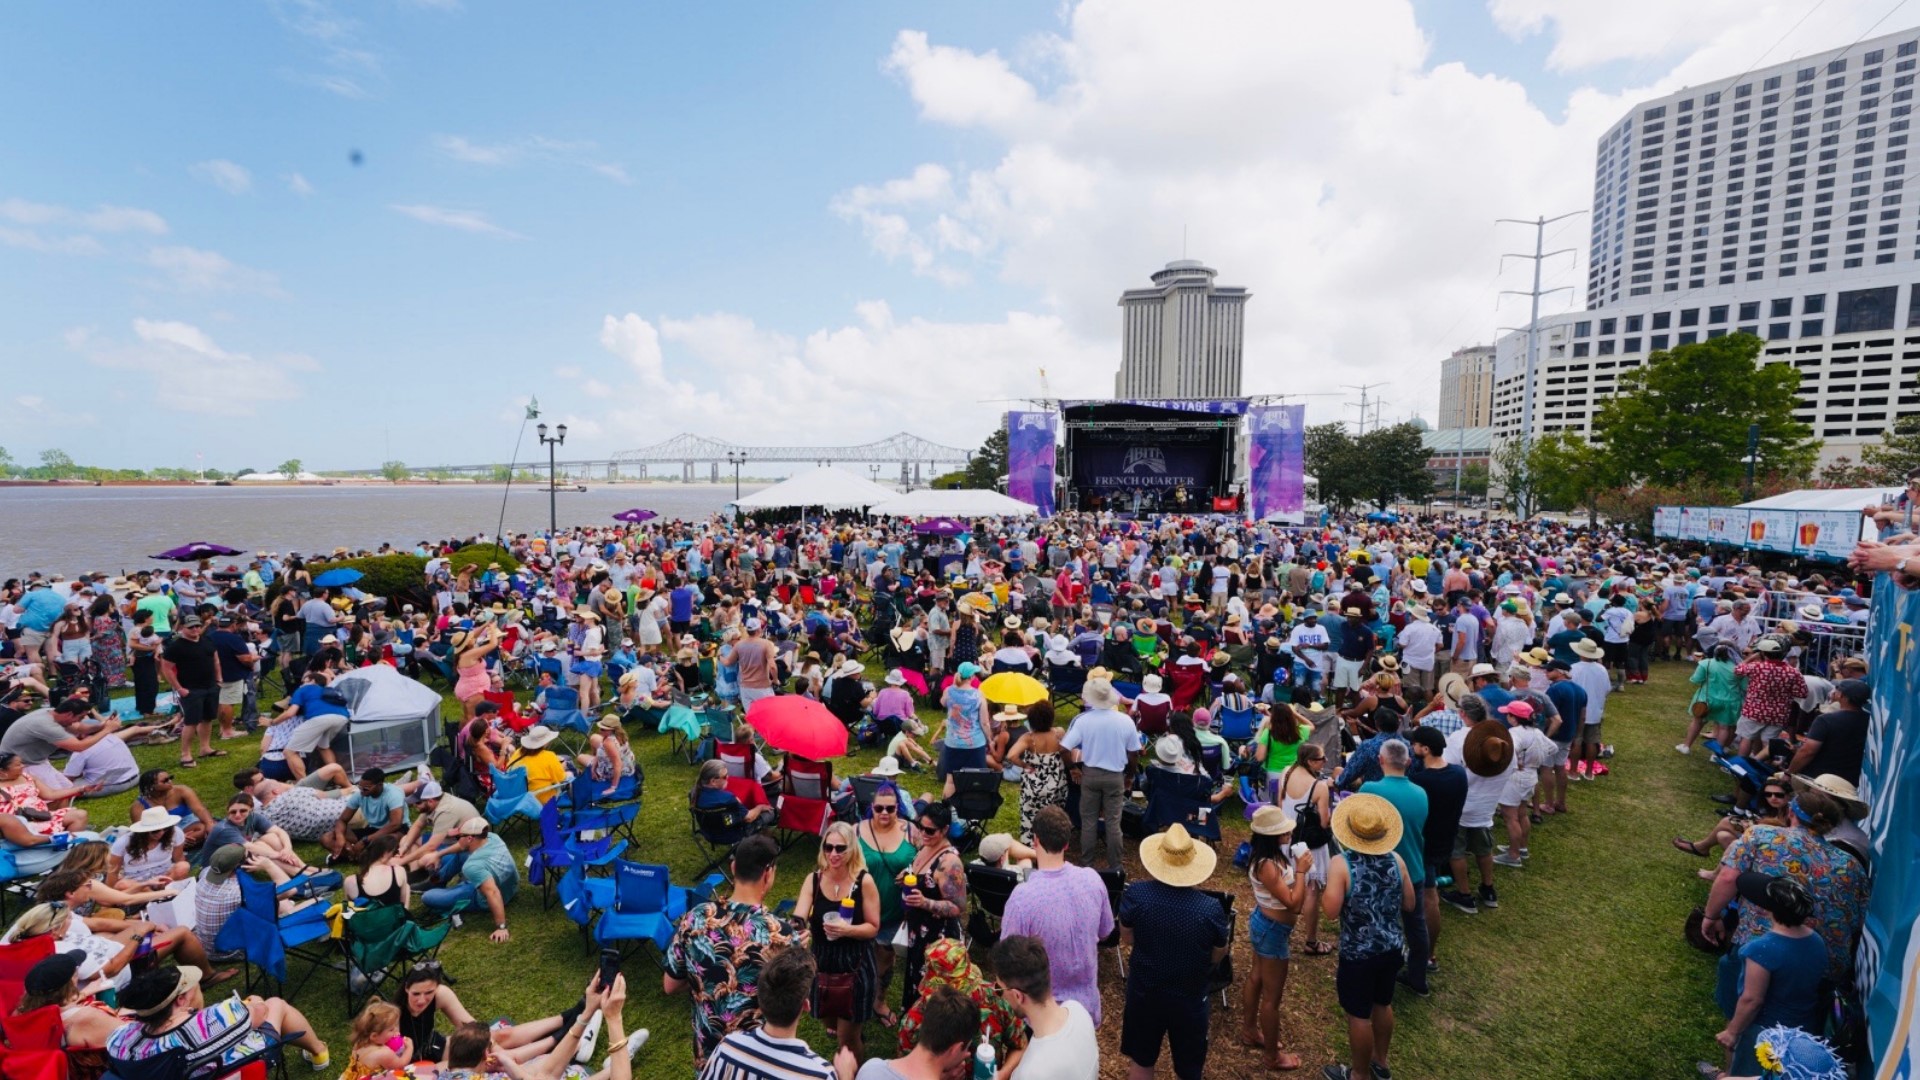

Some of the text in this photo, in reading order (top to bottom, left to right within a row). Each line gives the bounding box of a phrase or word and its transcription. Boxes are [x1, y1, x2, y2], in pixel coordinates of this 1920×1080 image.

[1172, 401, 1211, 412] STAGE
[1123, 447, 1165, 466] ABITA
[1095, 476, 1195, 486] FRENCH QUARTER
[1298, 634, 1321, 645] NEVER
